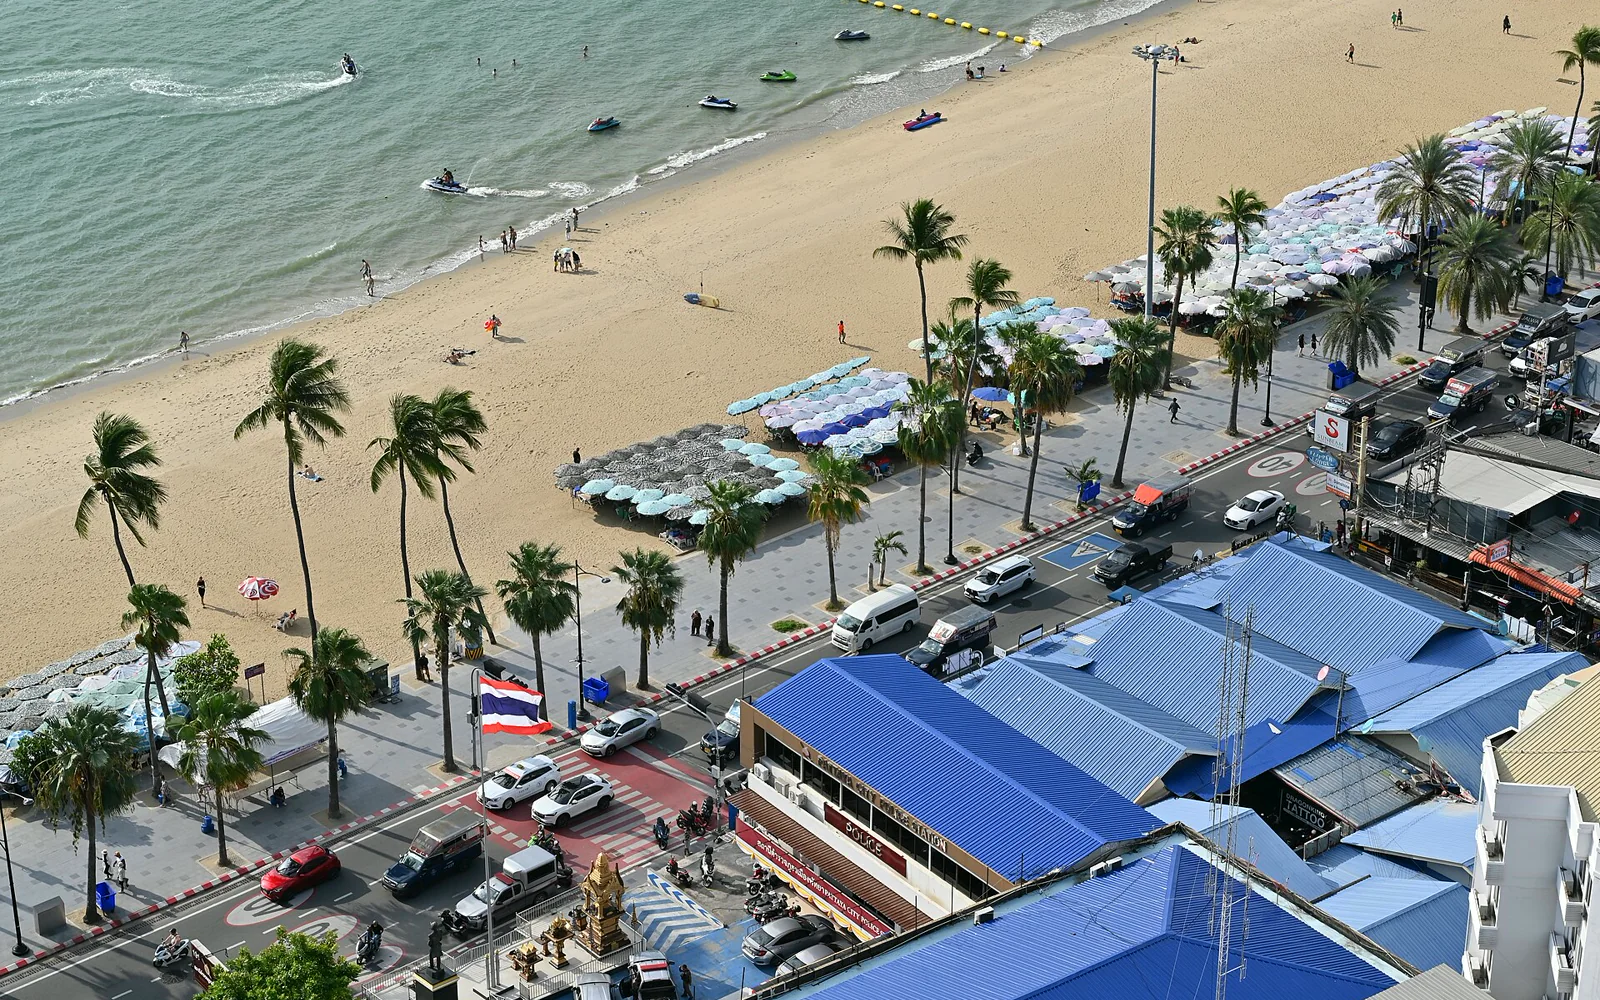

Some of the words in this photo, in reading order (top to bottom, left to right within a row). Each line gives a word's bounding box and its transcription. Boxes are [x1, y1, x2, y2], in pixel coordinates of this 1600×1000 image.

[1317, 433, 1344, 448] SUNBEAM
[1257, 456, 1295, 472] 40
[1286, 792, 1325, 819] DRAGONKING
[1286, 799, 1325, 829] TATTOO
[846, 821, 882, 857] POLICE
[911, 820, 948, 853] STATION
[846, 906, 861, 920] CITY
[860, 916, 880, 935] POLICE
